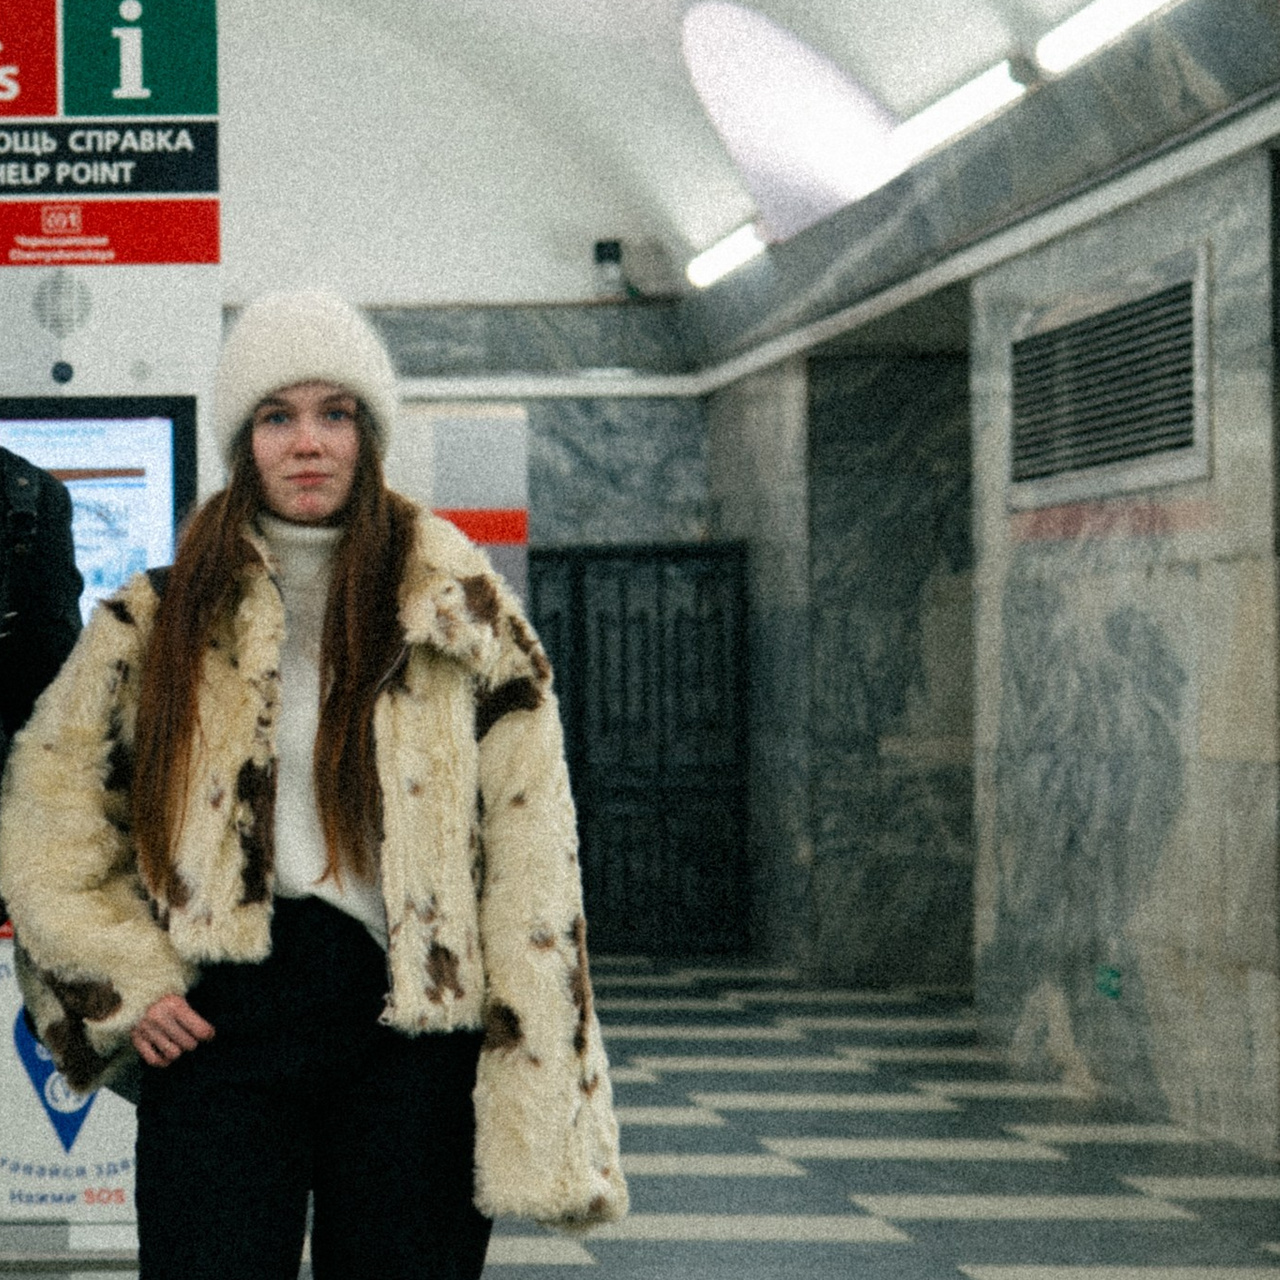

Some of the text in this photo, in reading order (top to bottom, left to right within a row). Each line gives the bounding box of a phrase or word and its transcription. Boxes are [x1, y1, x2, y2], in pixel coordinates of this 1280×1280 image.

[69, 129, 194, 153] СПРАВКА
[56, 162, 135, 184] POINT
[83, 1187, 126, 1204] SOS
